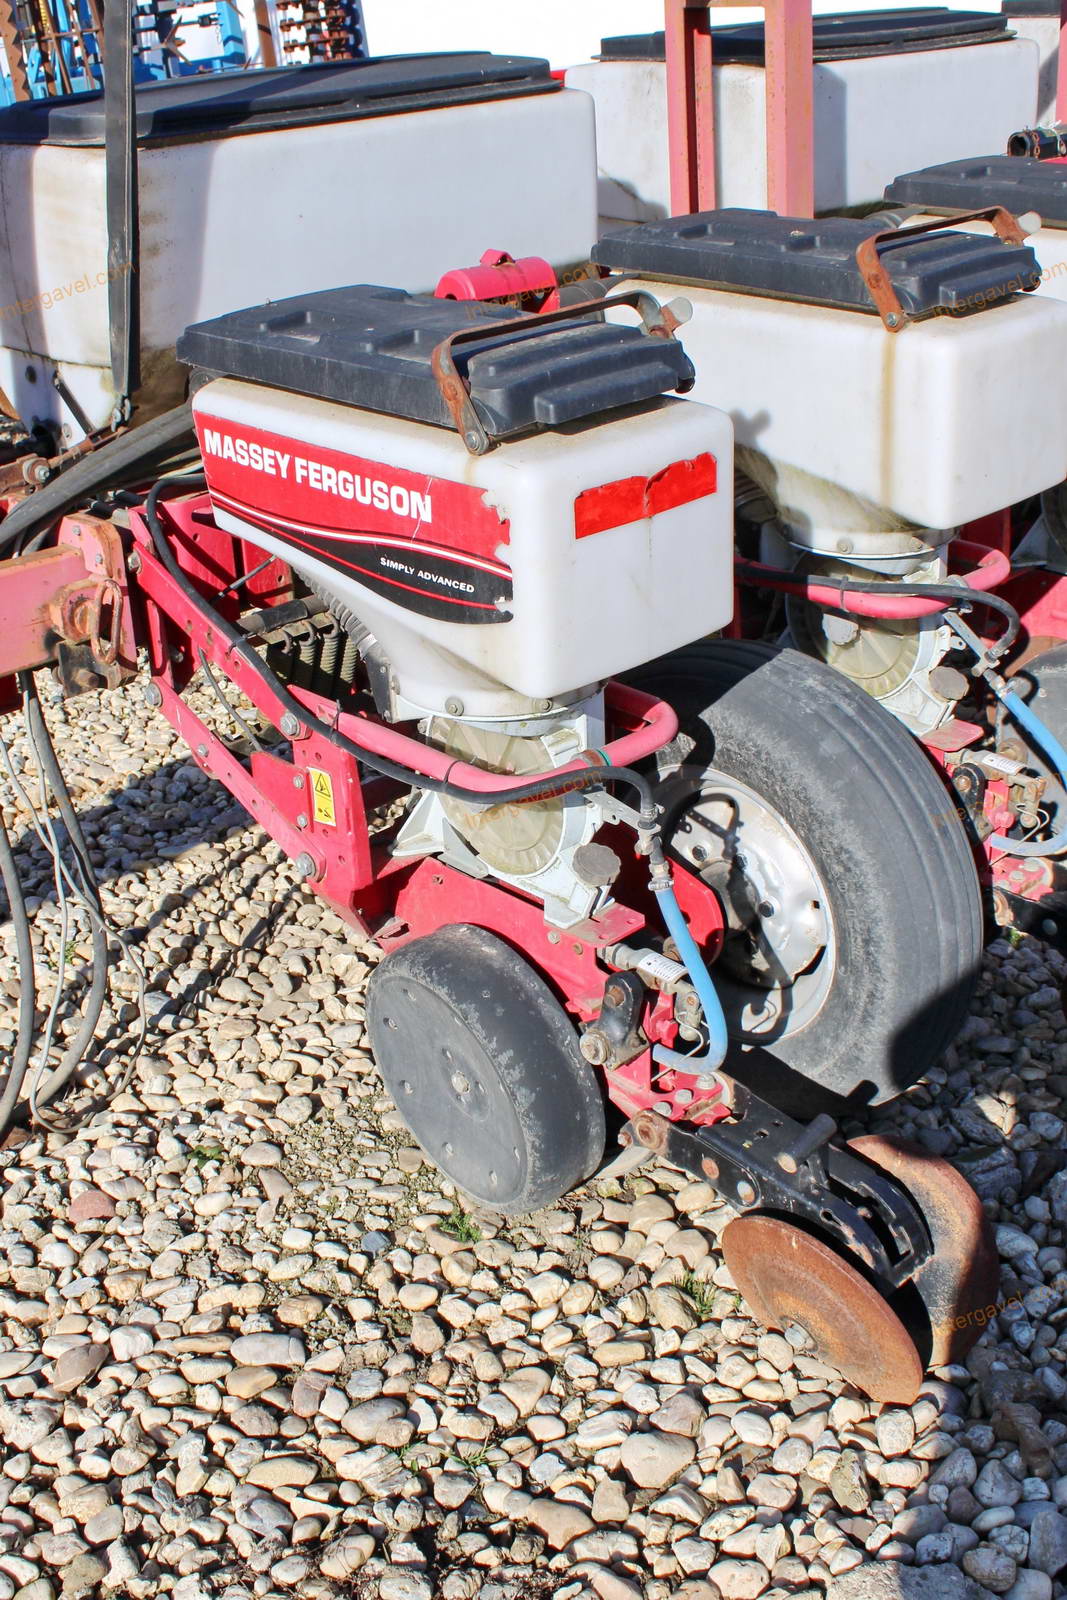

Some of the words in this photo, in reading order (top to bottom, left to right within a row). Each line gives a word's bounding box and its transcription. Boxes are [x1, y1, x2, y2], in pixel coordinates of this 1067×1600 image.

[203, 428, 292, 479] MASSEY
[294, 456, 432, 523] FERGUSON
[380, 557, 415, 575] SIMPLY
[417, 570, 475, 593] ADVANCED
